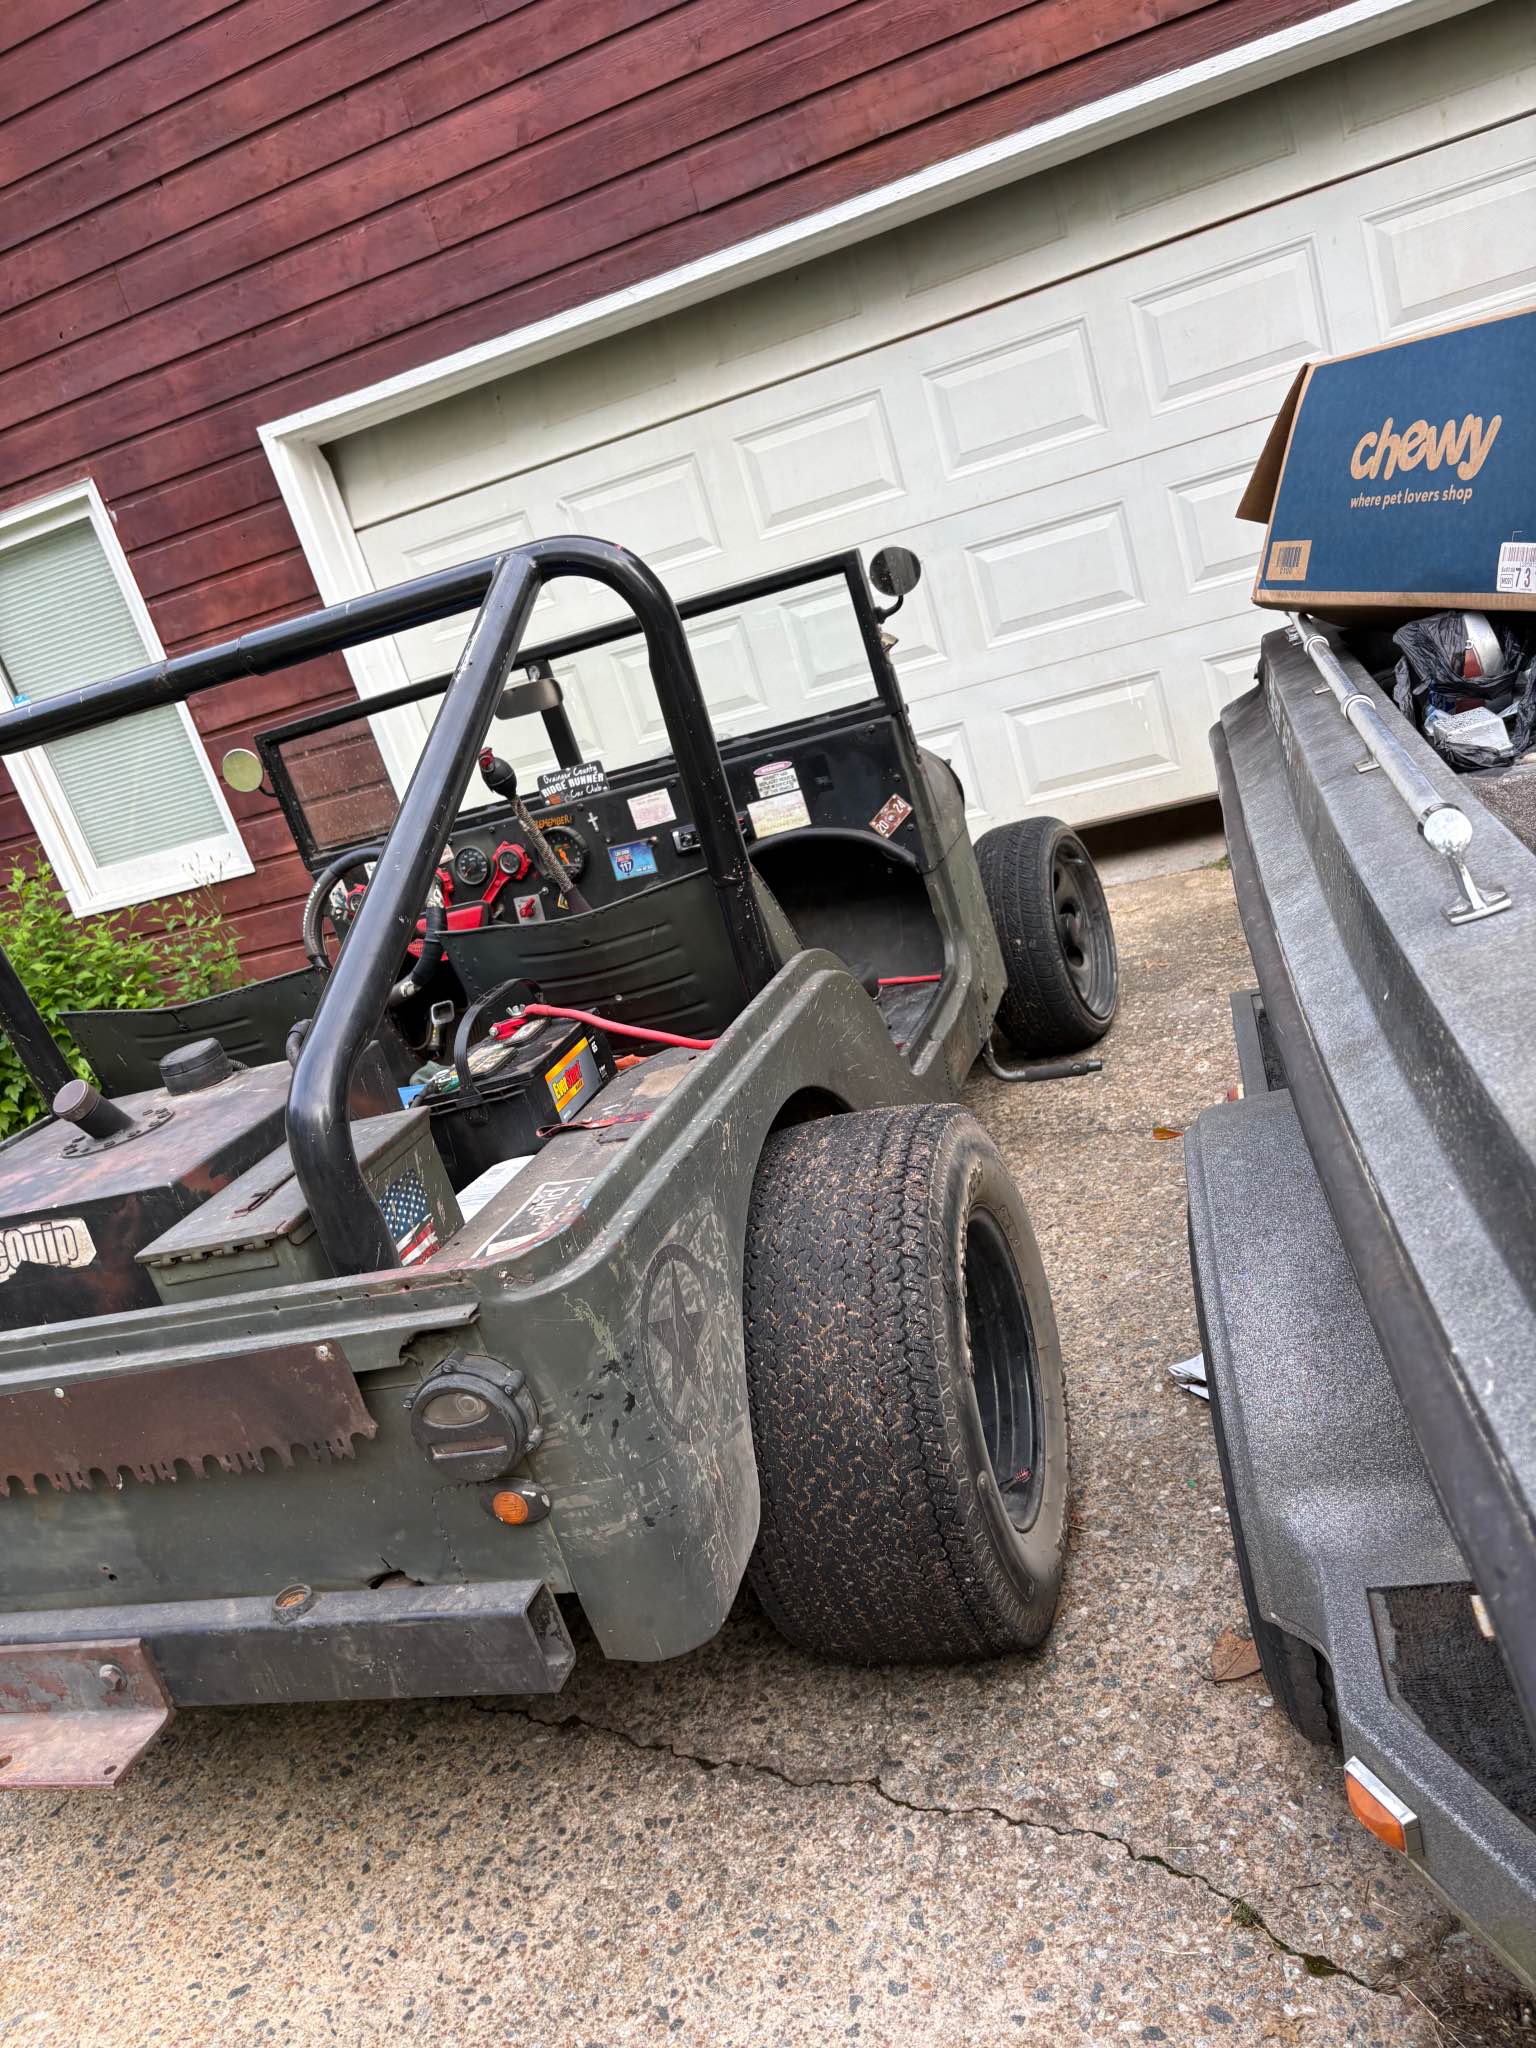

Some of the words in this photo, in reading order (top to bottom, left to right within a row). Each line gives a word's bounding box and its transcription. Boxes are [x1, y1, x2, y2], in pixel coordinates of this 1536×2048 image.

[1350, 413, 1502, 480] chewy
[1350, 491, 1381, 508] where
[1382, 489, 1403, 510] pet
[1404, 488, 1440, 505] lovers
[1442, 484, 1473, 505] shop
[572, 765, 598, 777] County
[541, 783, 568, 798] RIDGE
[568, 772, 604, 788] RUNNER
[585, 784, 602, 794] Club
[875, 820, 889, 834] 20
[892, 799, 906, 814] 24
